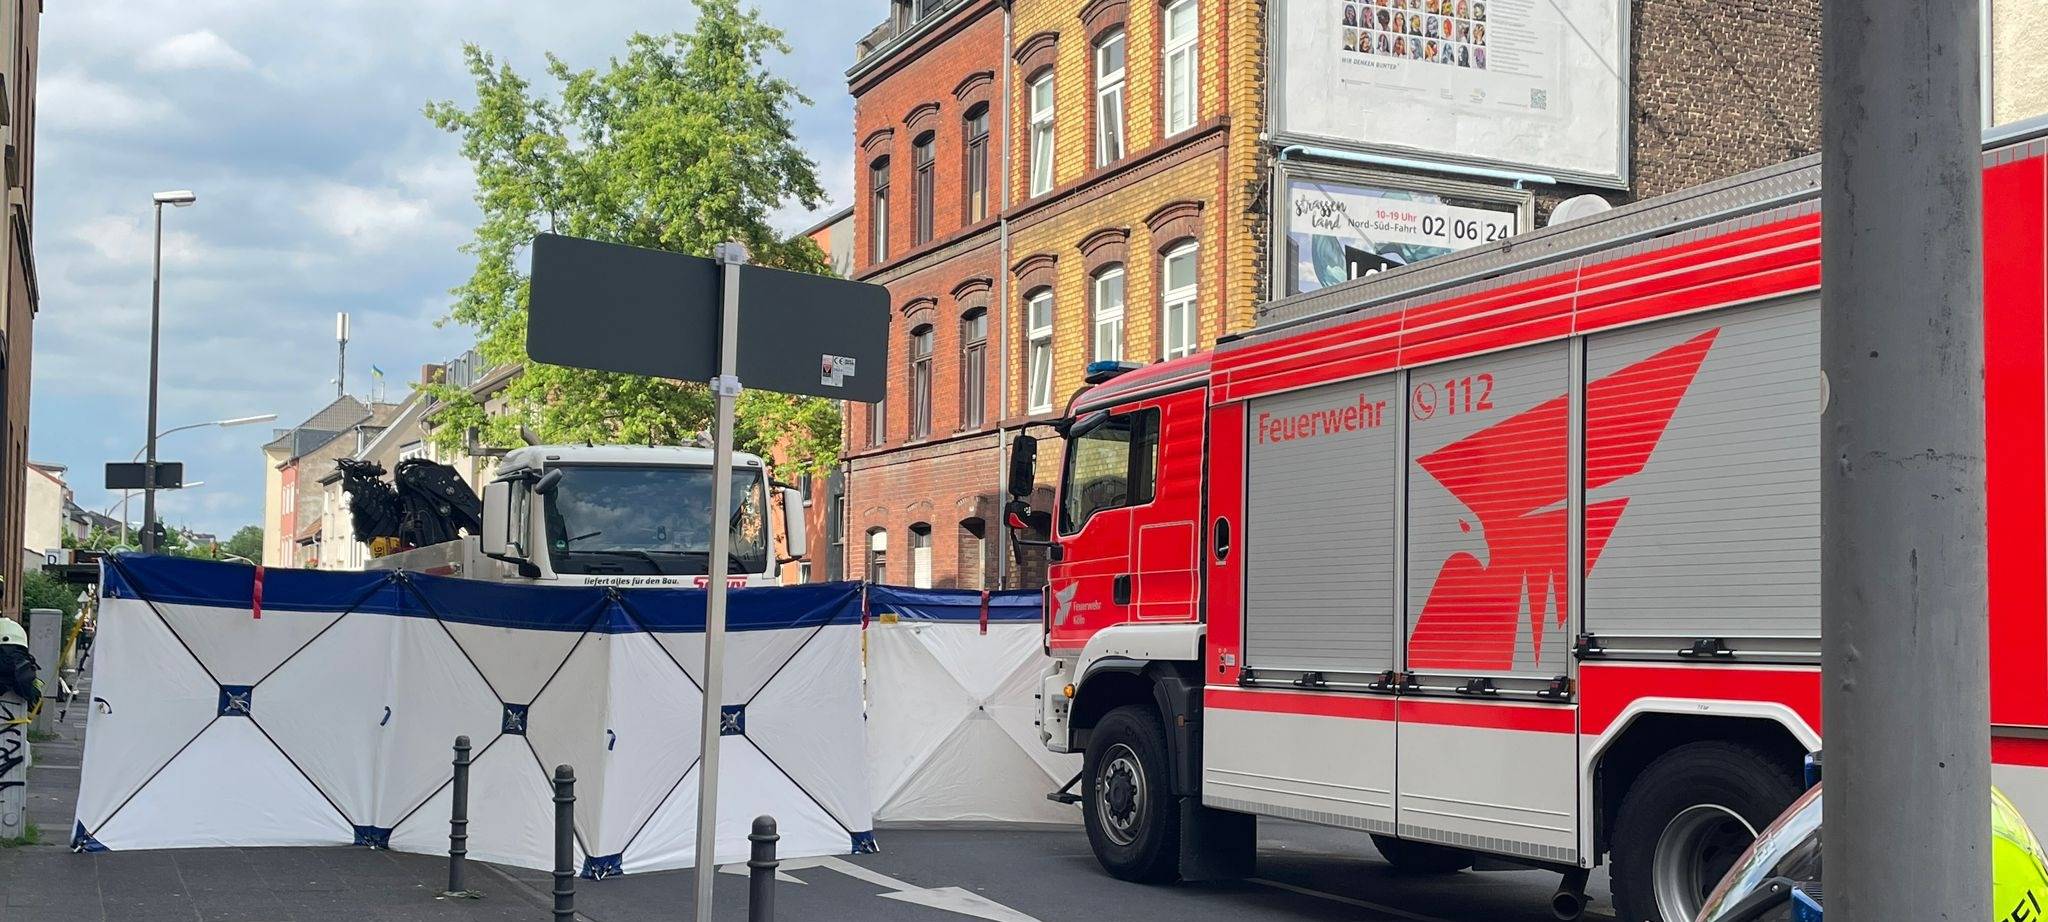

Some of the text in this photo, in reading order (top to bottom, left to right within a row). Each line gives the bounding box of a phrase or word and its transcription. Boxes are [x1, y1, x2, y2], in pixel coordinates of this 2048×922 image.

[1295, 194, 1346, 217] strassen
[1312, 210, 1341, 230] land
[1348, 218, 1417, 234] Nord-Süd-Fahrt
[1377, 210, 1417, 222] 10-19 Uhr
[1422, 216, 1508, 242] 02 06 24
[1445, 373, 1494, 416] 112
[1257, 393, 1386, 444] Feuerwehr
[584, 577, 609, 586] liefert
[610, 577, 630, 585] alles
[631, 577, 643, 586] für
[1072, 599, 1101, 612] Feuerwehr
